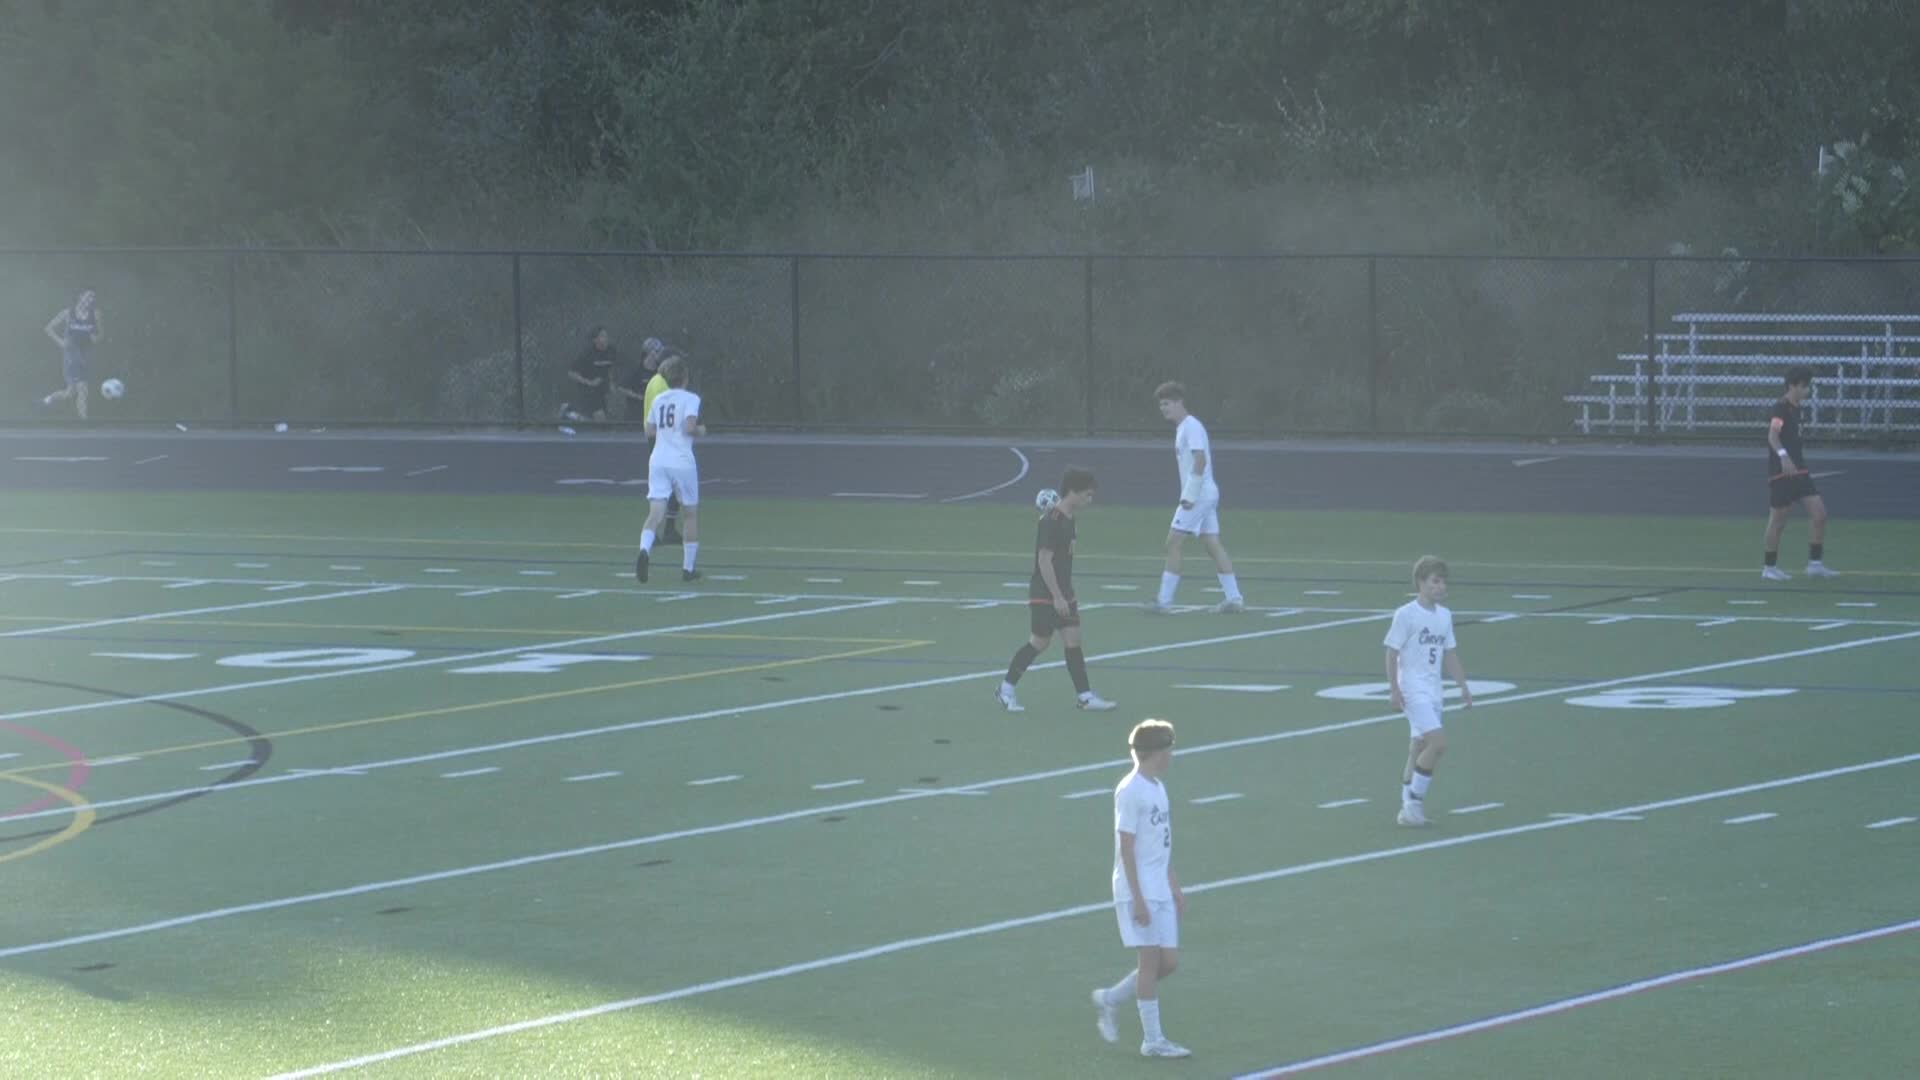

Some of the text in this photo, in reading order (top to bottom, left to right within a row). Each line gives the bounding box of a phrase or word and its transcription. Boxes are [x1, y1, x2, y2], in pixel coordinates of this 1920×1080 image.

[659, 403, 676, 429] 16
[1429, 647, 1437, 665] 5
[1163, 826, 1170, 849] 2
